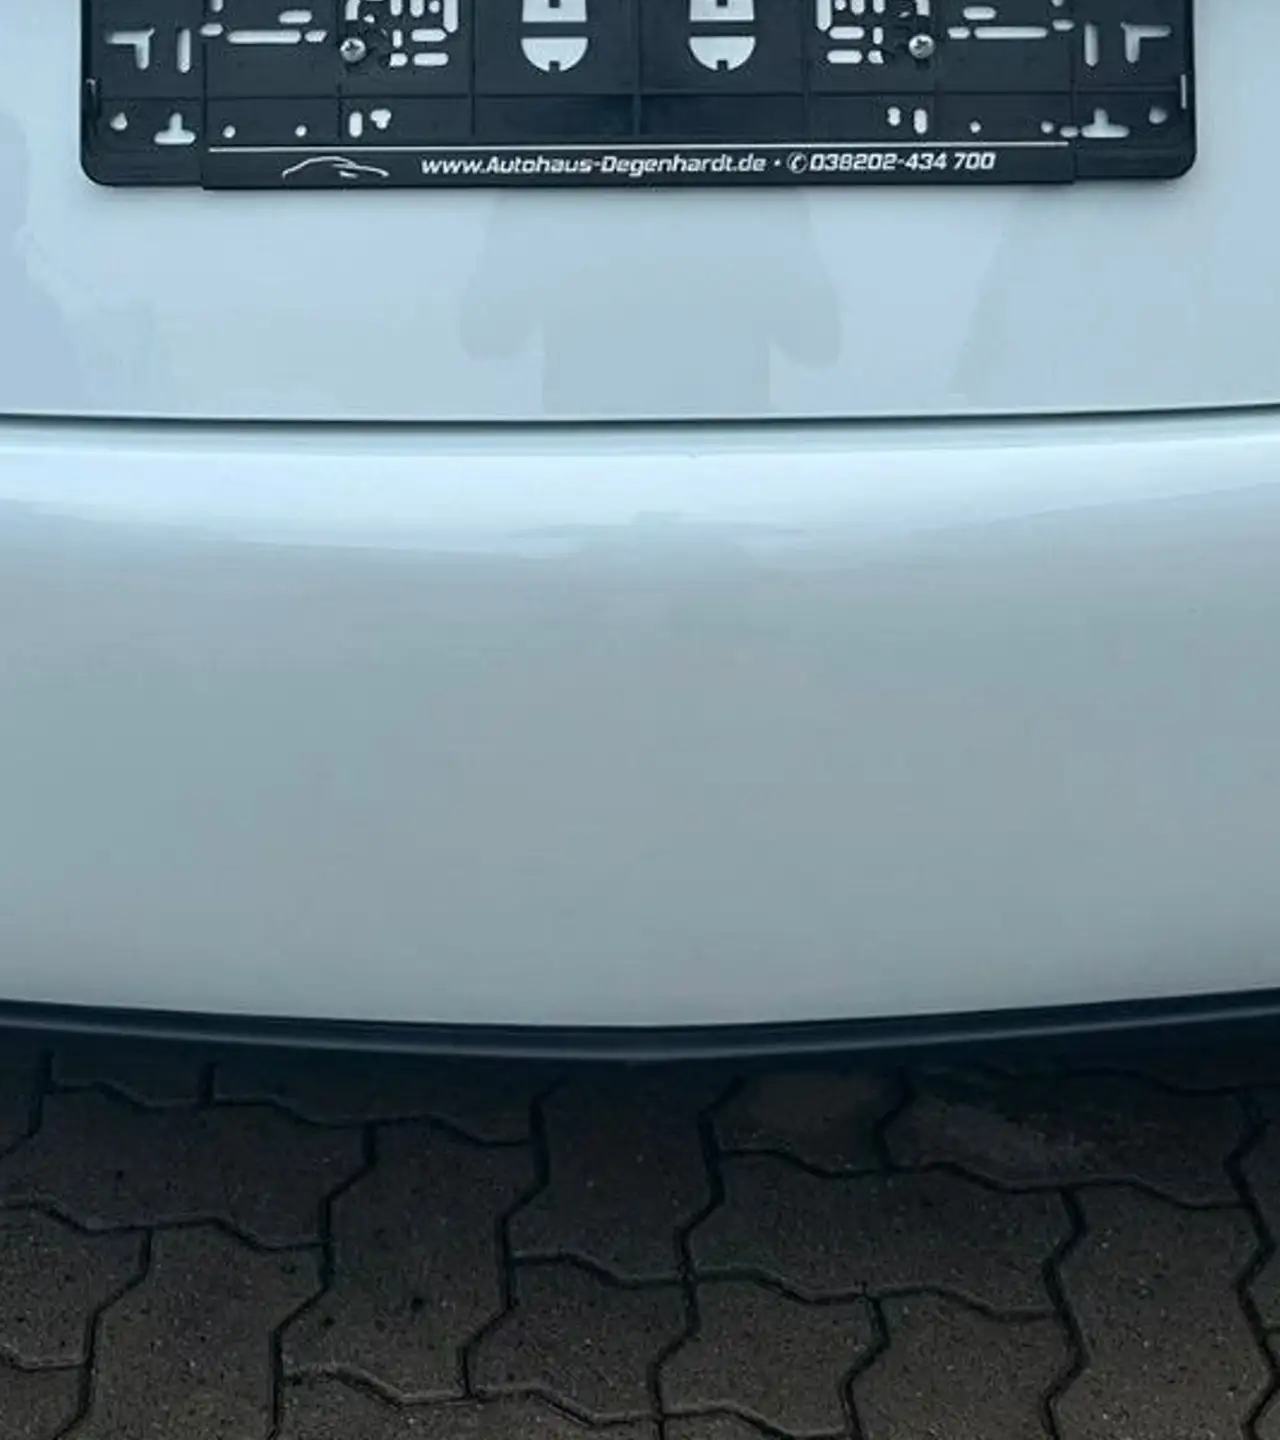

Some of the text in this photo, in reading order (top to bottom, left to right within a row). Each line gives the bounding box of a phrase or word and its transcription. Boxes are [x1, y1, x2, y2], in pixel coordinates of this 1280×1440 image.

[421, 152, 996, 178] www.Autohaus-Degenhardt.de 038202-434 700
